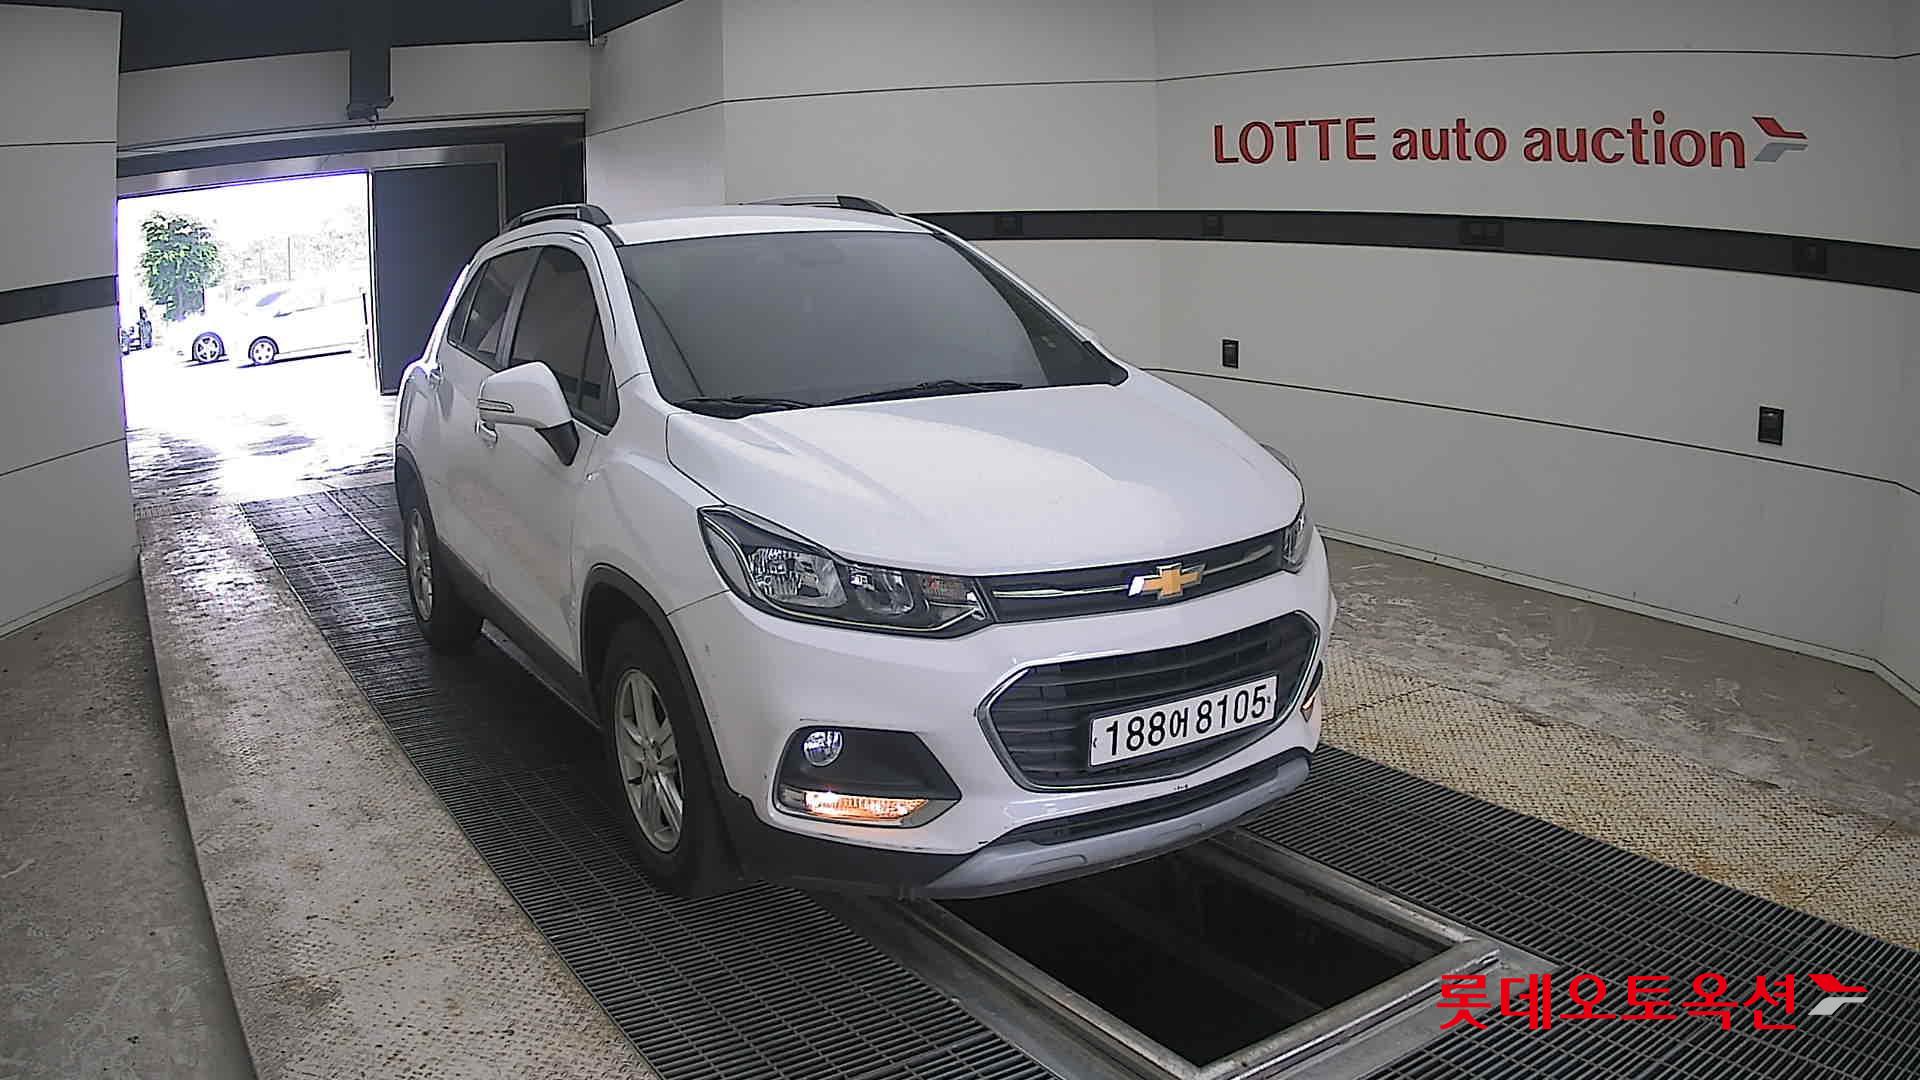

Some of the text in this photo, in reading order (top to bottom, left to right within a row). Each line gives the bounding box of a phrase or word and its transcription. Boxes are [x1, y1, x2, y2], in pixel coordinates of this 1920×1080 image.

[1214, 110, 1746, 168] LOTTE auto auction
